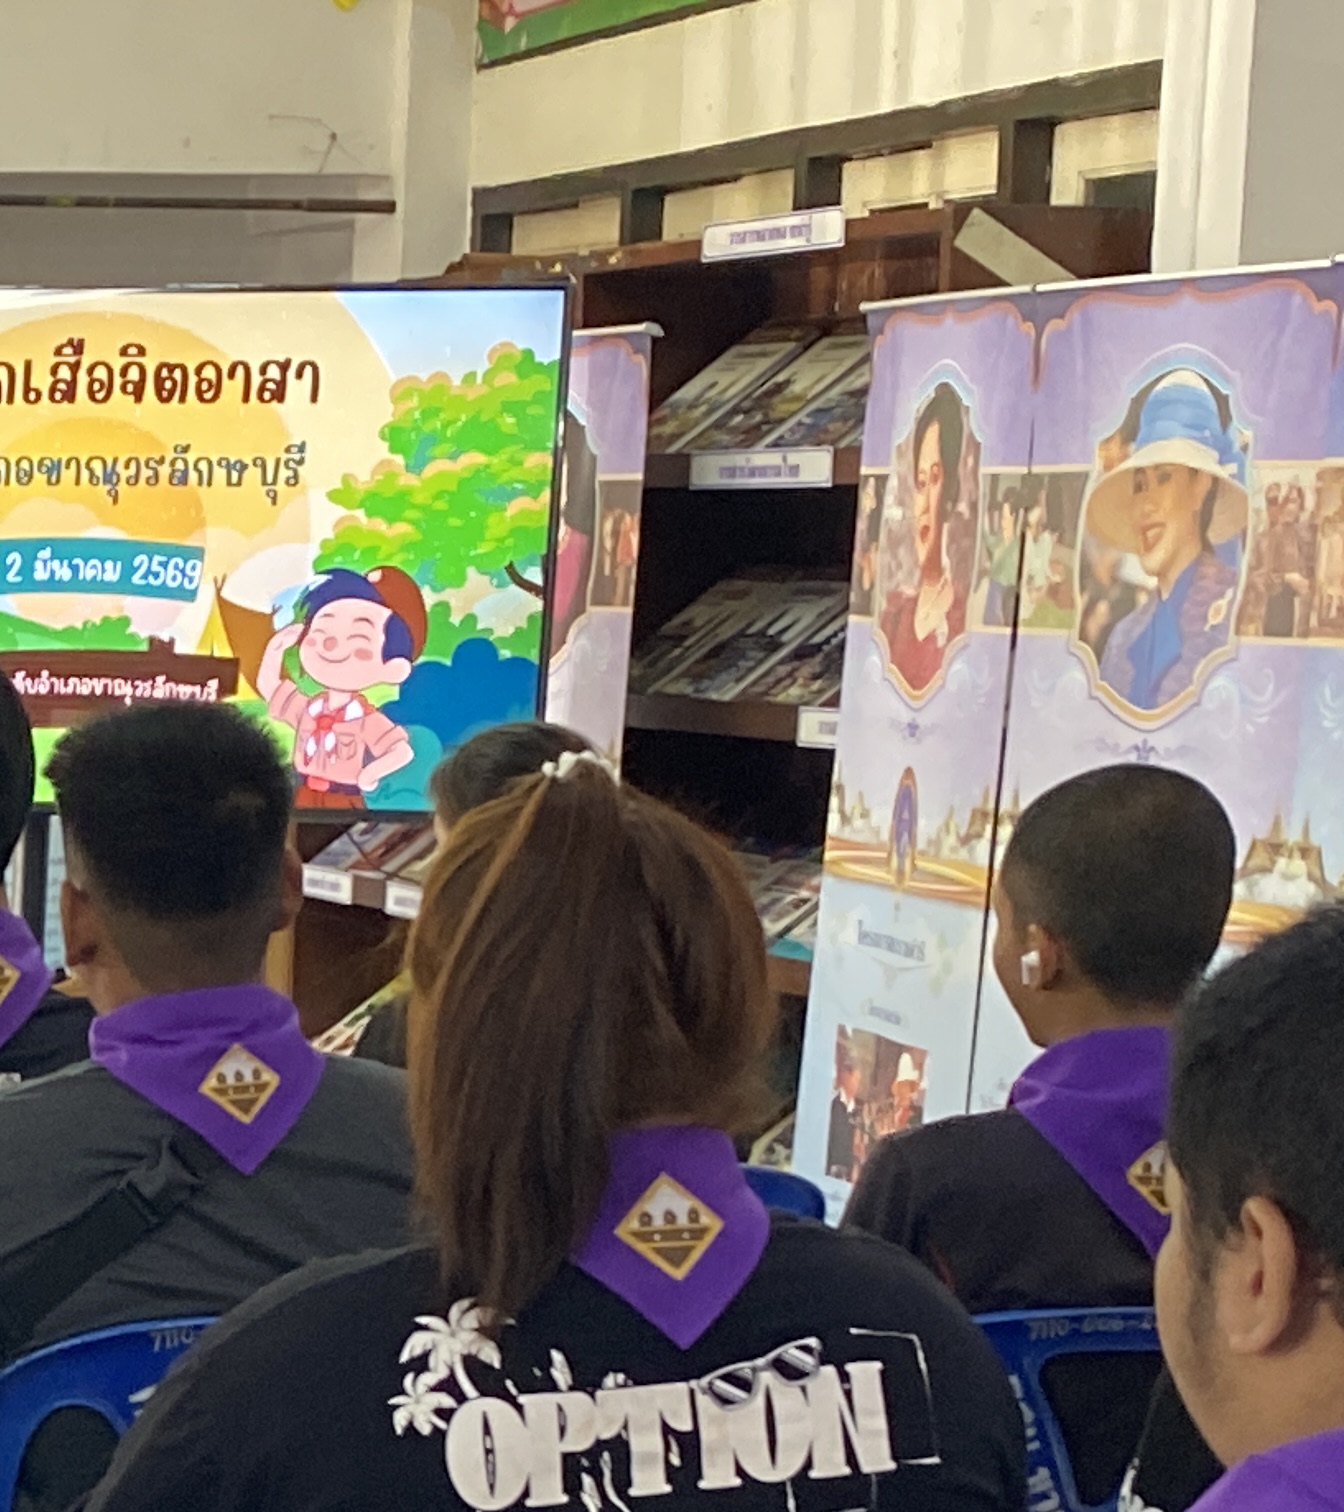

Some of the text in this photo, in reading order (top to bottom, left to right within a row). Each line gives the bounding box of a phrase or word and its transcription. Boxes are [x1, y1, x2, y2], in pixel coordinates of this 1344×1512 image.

[4, 550, 24, 584] 2
[32, 546, 122, 584] มีนาคม
[130, 552, 202, 591] 2569
[446, 1361, 897, 1511] OPTION
